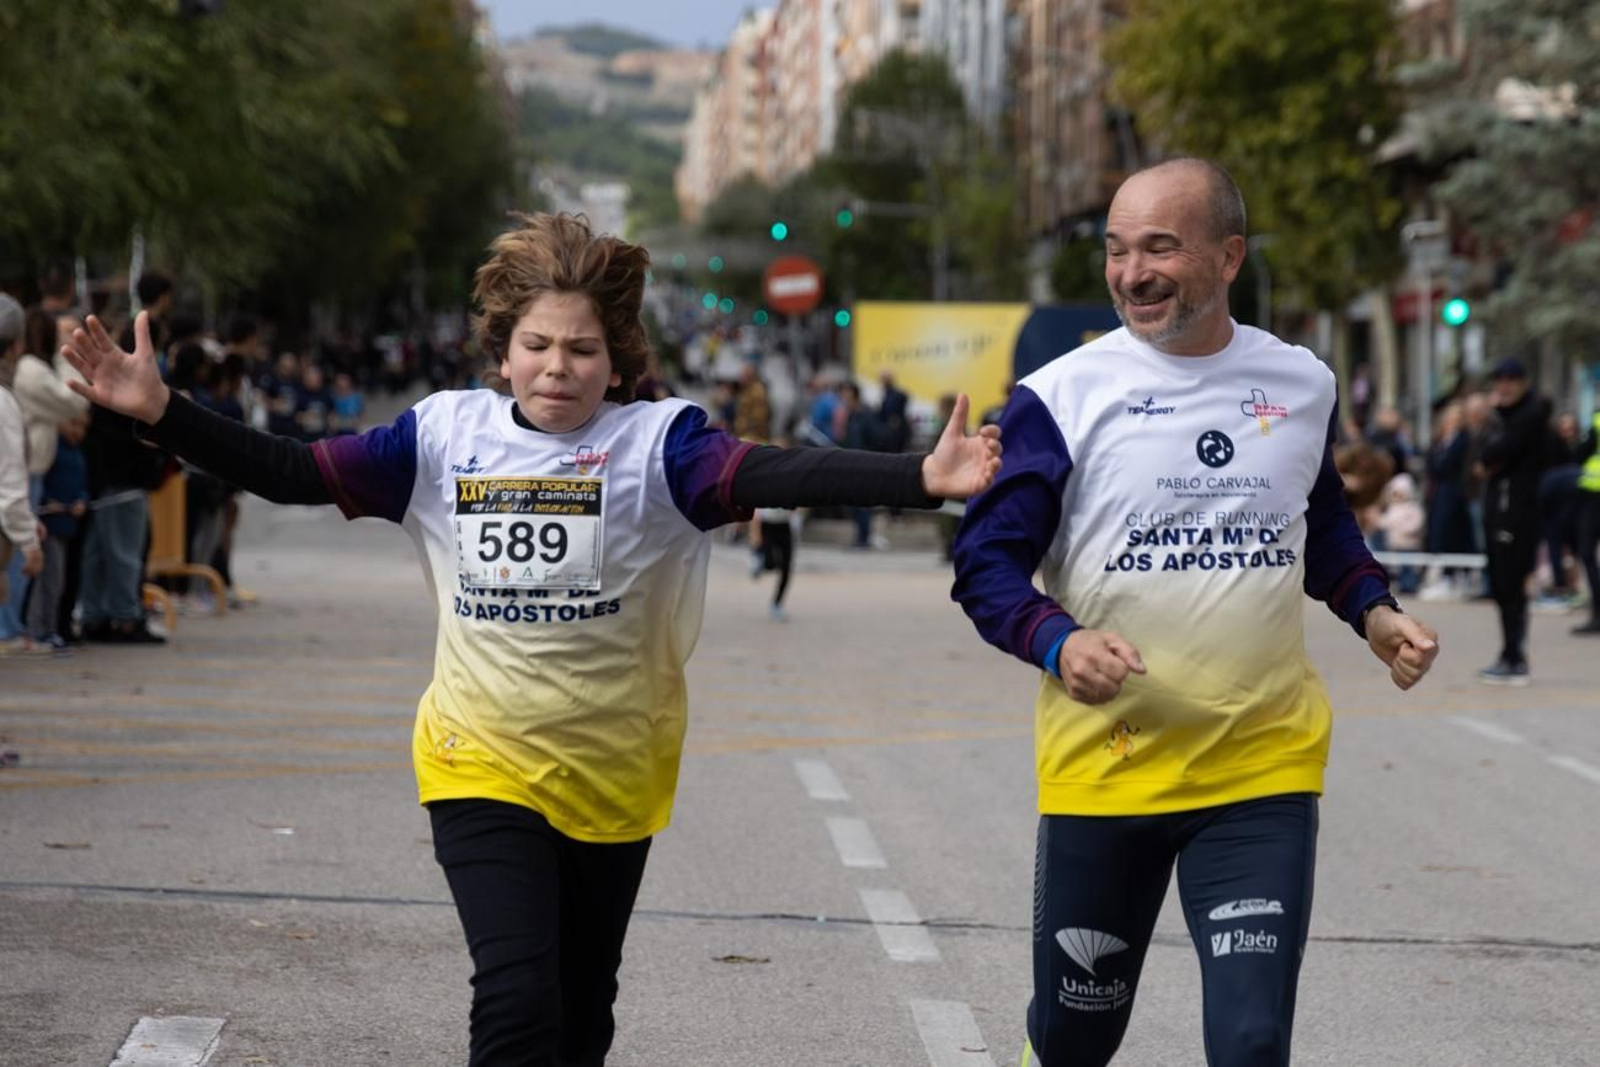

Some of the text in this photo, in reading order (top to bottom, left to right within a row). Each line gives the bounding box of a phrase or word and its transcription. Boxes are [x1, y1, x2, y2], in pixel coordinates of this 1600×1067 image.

[460, 480, 597, 502] XXV CARRERA POPULAR
[1157, 477, 1272, 490] PABLO CARVAJAL
[488, 491, 597, 502] y gran caminata
[1126, 511, 1291, 529] CLUB DE RUNNING
[478, 521, 568, 563] 589
[1127, 527, 1213, 547] SANTA
[1104, 547, 1297, 572] LOS APÓSTOLES
[475, 599, 621, 623] APÓSTOLES
[1233, 929, 1278, 949] Jaén
[1062, 975, 1127, 999] Unicaja
